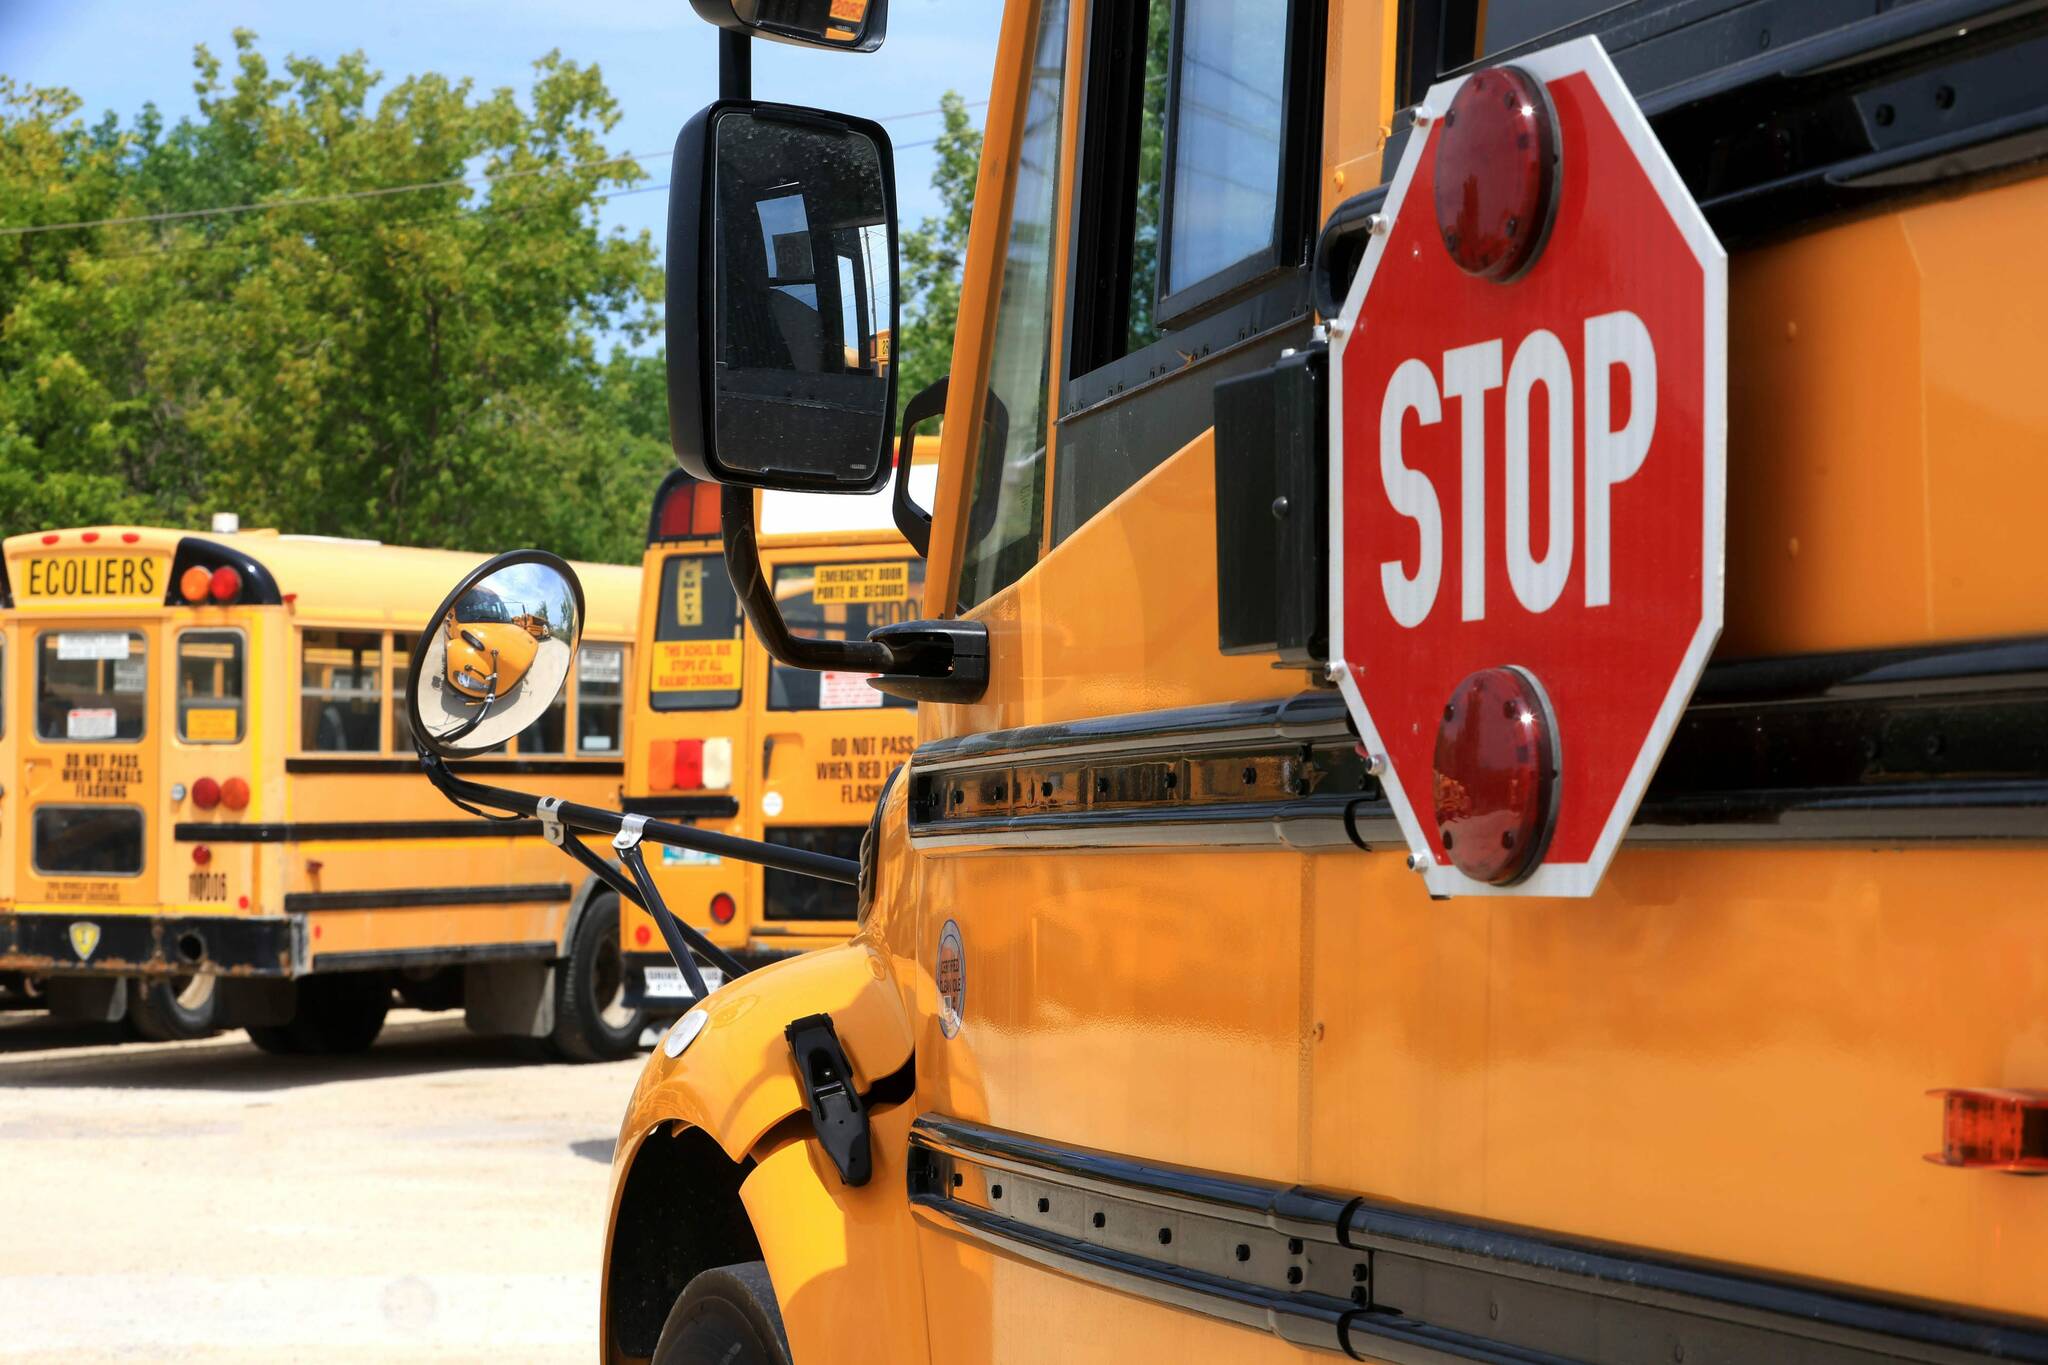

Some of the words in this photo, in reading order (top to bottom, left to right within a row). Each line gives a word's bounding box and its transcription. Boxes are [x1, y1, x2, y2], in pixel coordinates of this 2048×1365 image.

[1379, 308, 1659, 630] STOP
[29, 558, 155, 595] ECOLIERS
[819, 567, 874, 583] EMERGENCY
[879, 567, 902, 580] DOOR
[817, 585, 845, 600] PORTE
[849, 584, 859, 598] DE
[864, 584, 904, 598] SECOURS
[831, 737, 847, 757] DO
[852, 737, 876, 756] NOT
[881, 736, 914, 755] PASS
[66, 752, 79, 768] DO
[85, 752, 104, 768] NOT
[110, 752, 139, 768] PASS
[62, 768, 91, 783] WHEN
[97, 768, 143, 784] SIGNALS
[816, 761, 852, 779] WHEN
[857, 761, 881, 779] RED
[75, 784, 127, 798] FLASHING
[841, 784, 884, 803] FLASH
